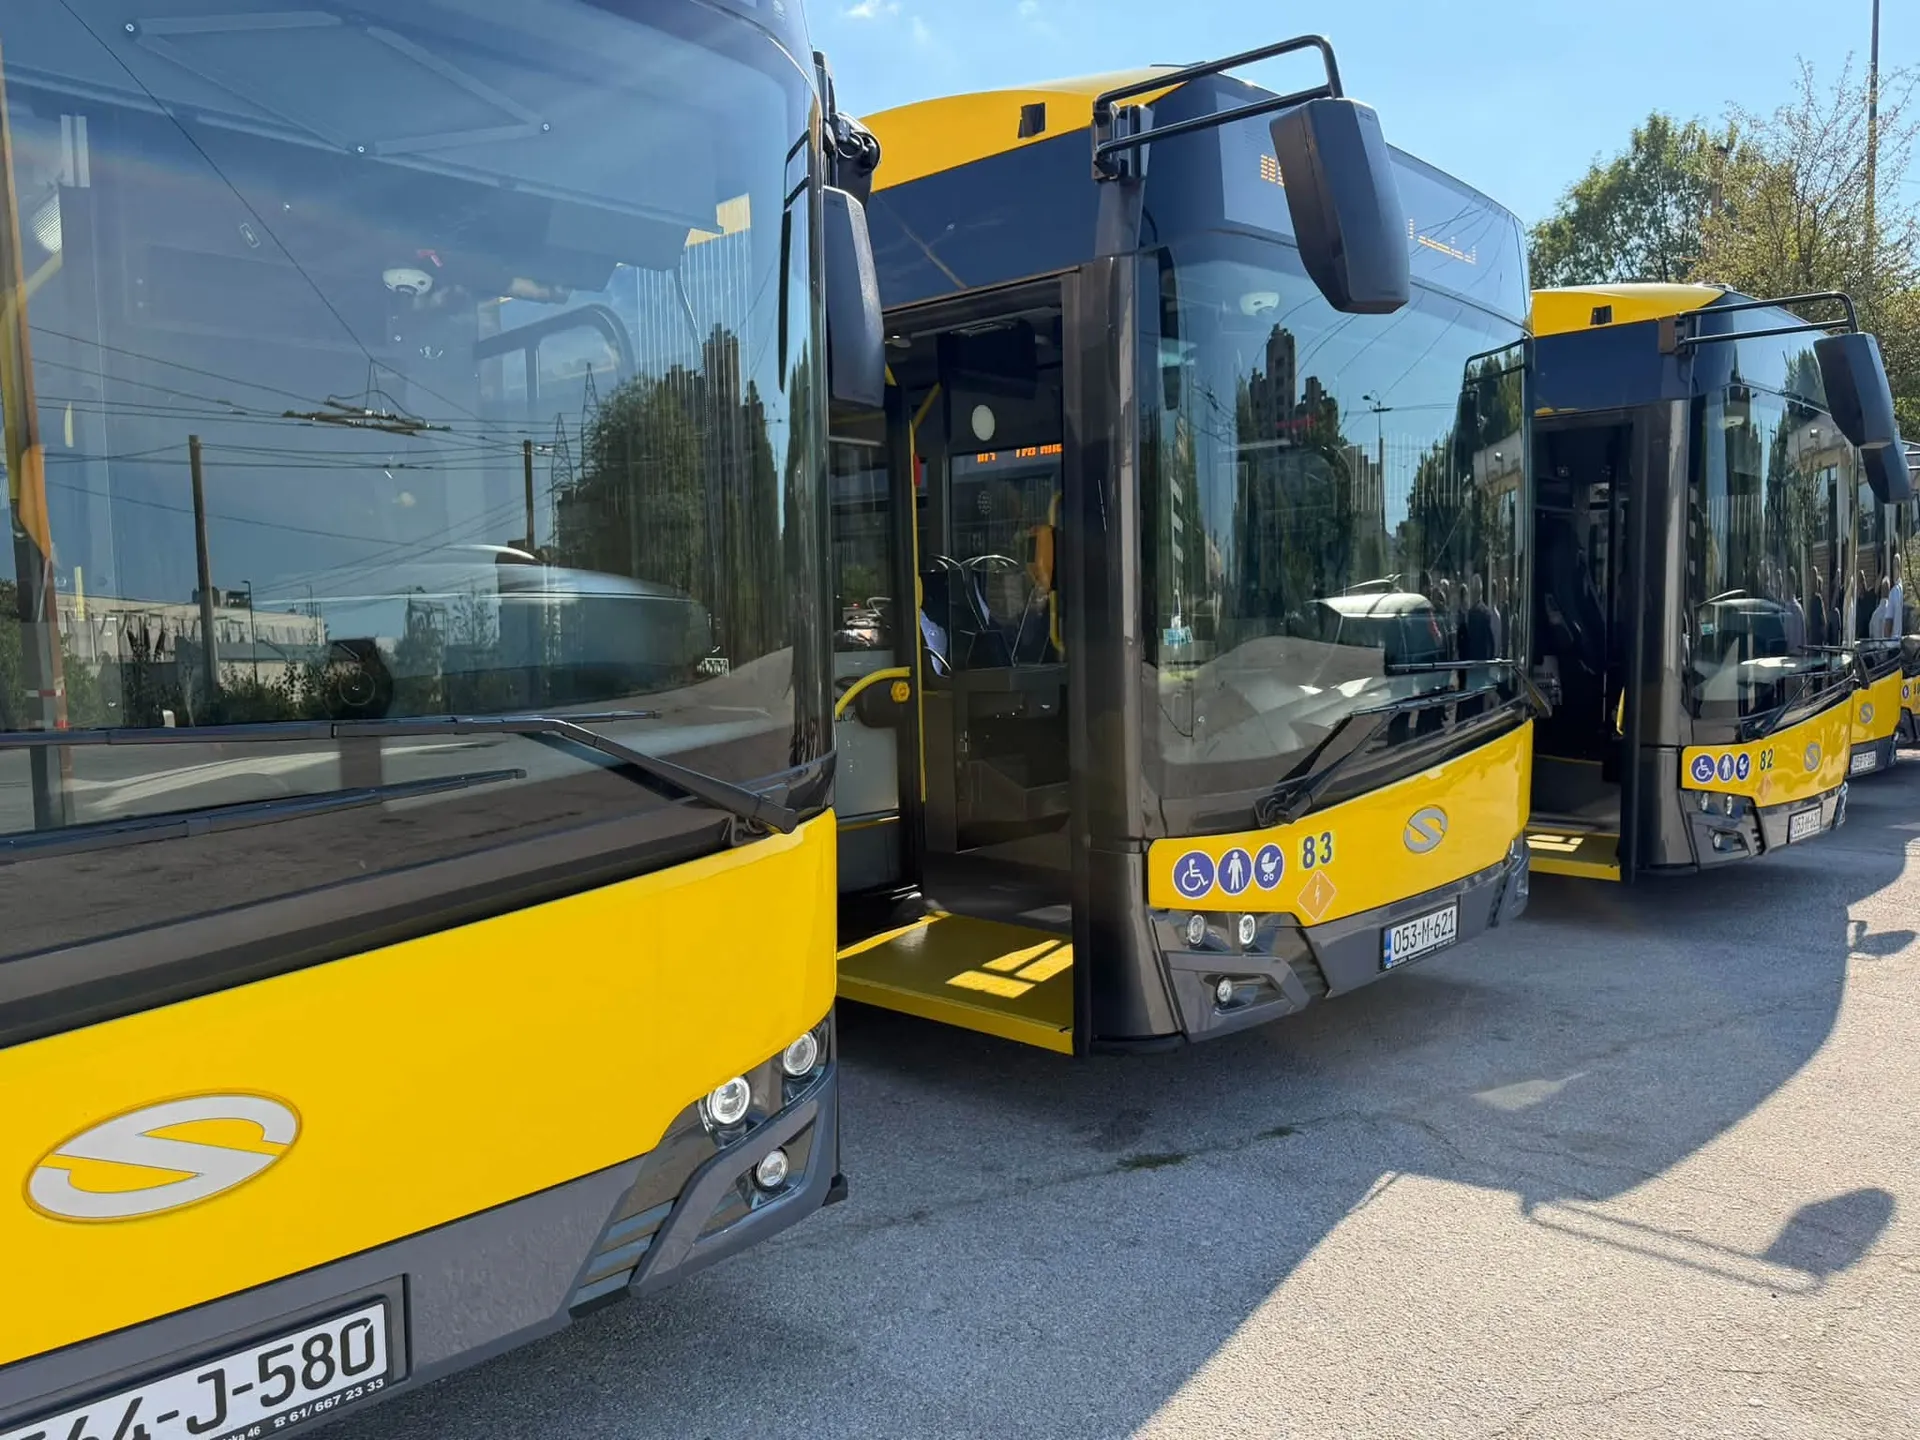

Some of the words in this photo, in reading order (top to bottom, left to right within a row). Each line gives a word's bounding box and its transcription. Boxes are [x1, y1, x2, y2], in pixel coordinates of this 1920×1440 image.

[1759, 748, 1774, 771] 82
[1302, 831, 1333, 869] 83
[1393, 910, 1454, 955] 053-M-621
[247, 1425, 261, 1440] 46
[345, 1386, 363, 1402] 23
[366, 1378, 385, 1393] 33
